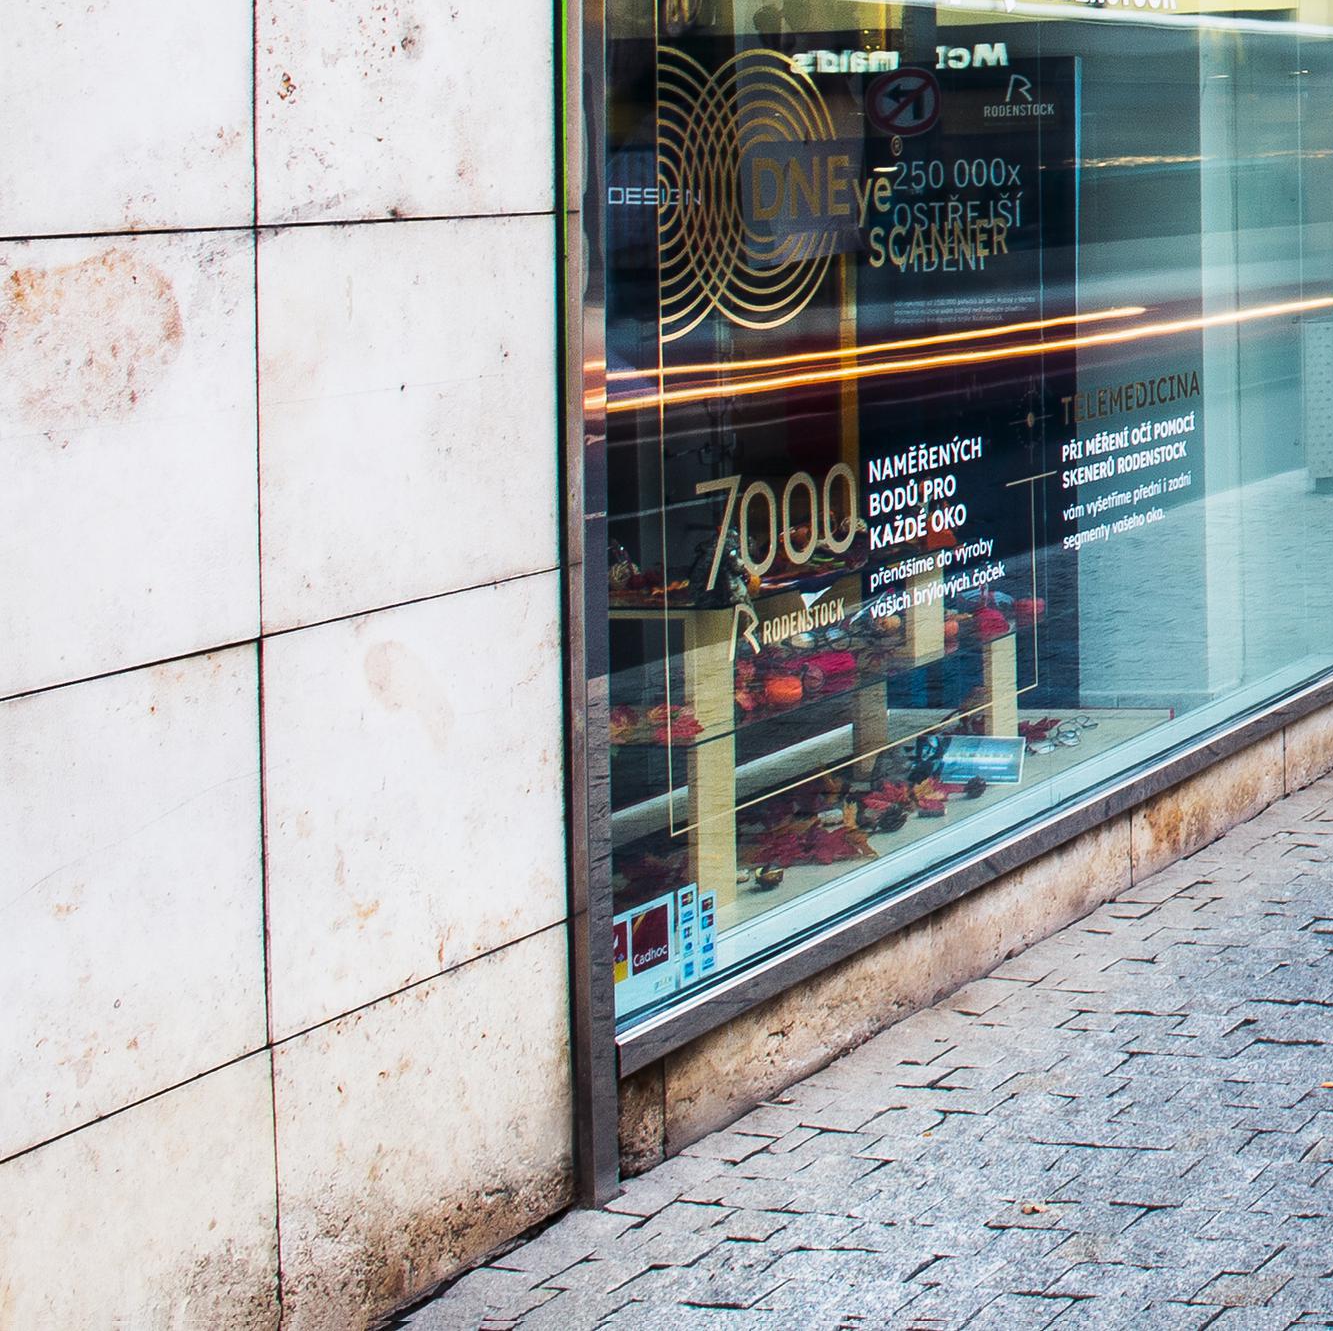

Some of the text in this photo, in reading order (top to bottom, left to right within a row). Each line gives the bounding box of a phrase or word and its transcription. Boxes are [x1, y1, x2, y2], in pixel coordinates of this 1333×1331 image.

[983, 102, 1055, 119] RODENSTOCK
[893, 158, 1021, 190] 250 000x
[869, 217, 1008, 268] SCANNER
[1061, 371, 1200, 425] TELEMEDICINA
[868, 435, 982, 484] NAMĚŘENÝCH
[1062, 410, 1196, 463] PŘI MĚŘENÍ OČÍ POMOCÍ
[1062, 440, 1188, 489] SKENERŮ RODENSTOCK
[868, 474, 957, 517] BODŮ PRO
[1063, 470, 1192, 522] vám vyšetříme přední i zadní
[695, 462, 858, 591] 7000
[869, 503, 968, 550] KAŽDÉ OKO
[1063, 521, 1111, 551] segmenty
[1112, 513, 1145, 535] vašeho
[870, 537, 994, 593] přenášíme do výroby
[870, 560, 1007, 620] vašich brýlových čoček
[763, 597, 846, 645] RODENSTOCK
[632, 944, 668, 967] Cadhoc
